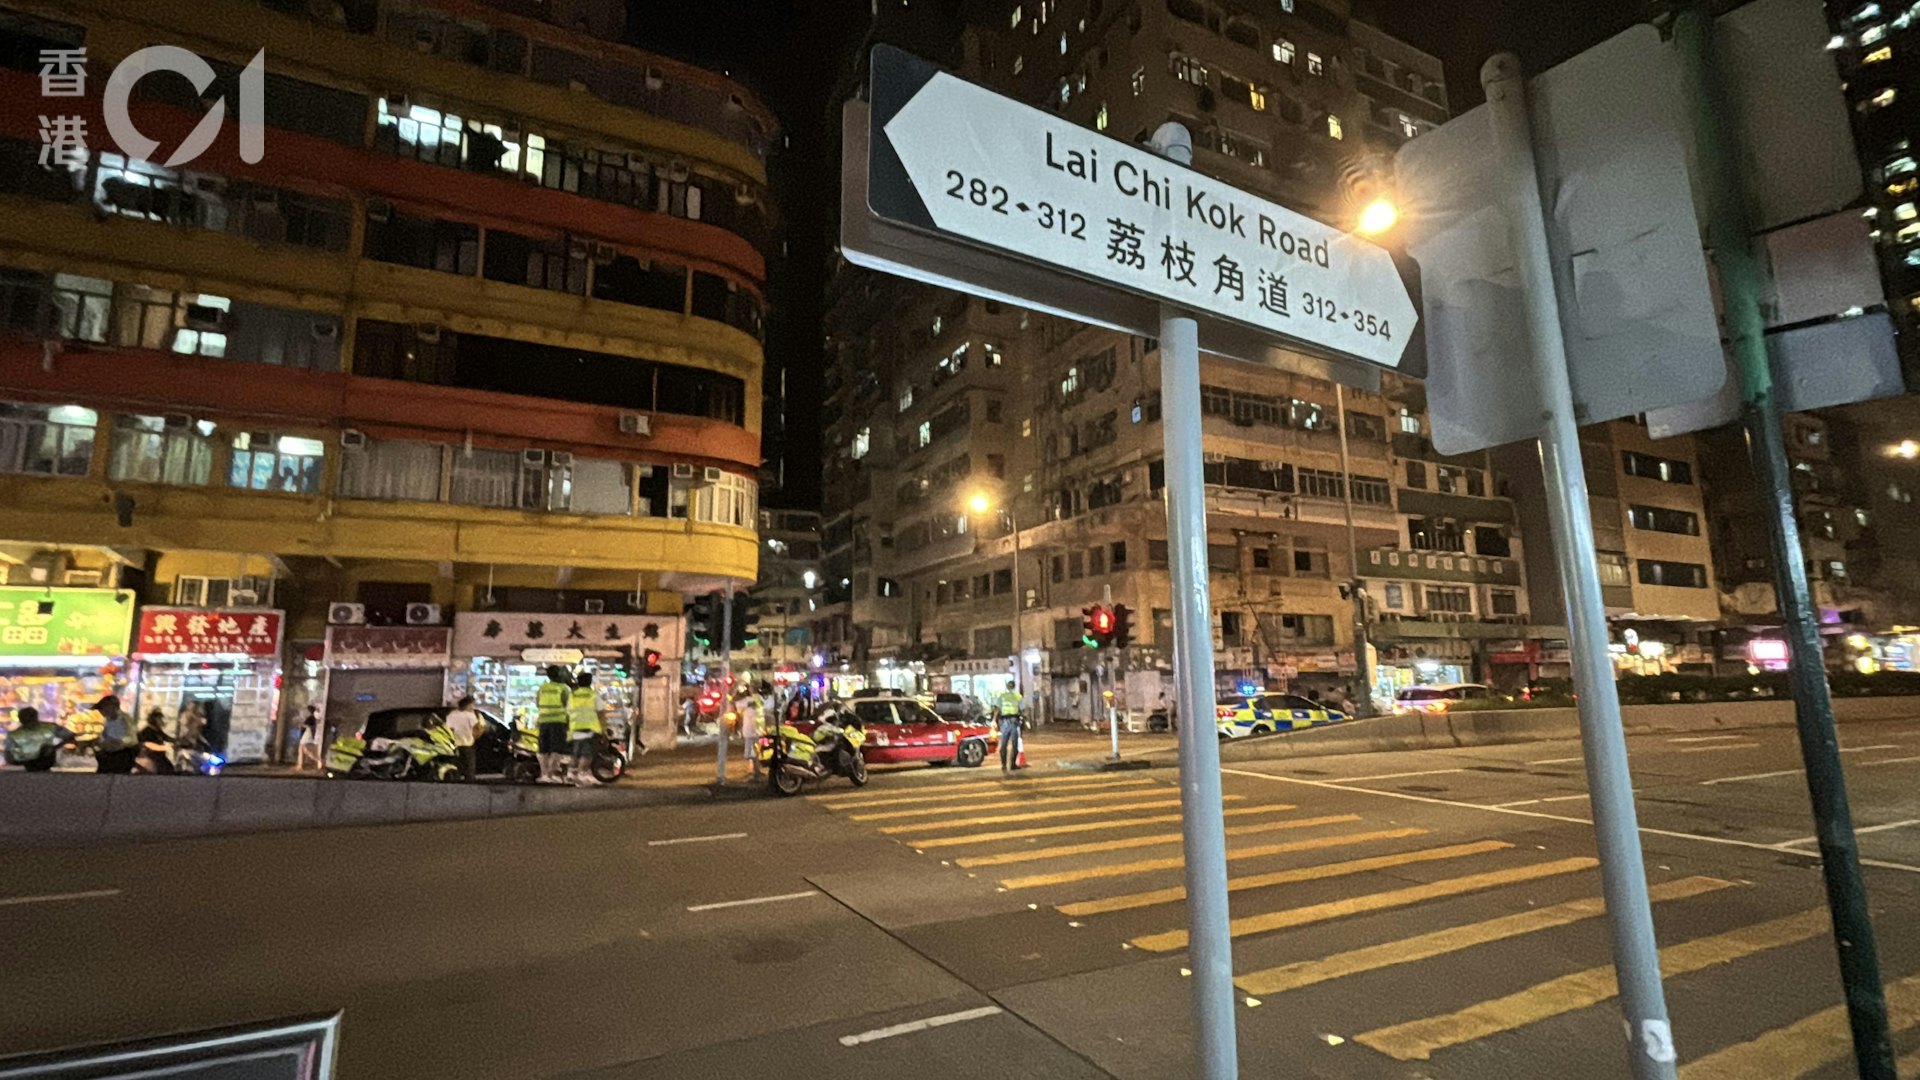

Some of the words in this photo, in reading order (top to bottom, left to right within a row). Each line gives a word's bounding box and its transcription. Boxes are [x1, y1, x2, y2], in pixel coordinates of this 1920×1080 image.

[1046, 131, 1097, 183] Lai
[1114, 160, 1171, 210] Chi
[1187, 186, 1246, 238] Kok
[1259, 213, 1329, 269] Road
[1106, 217, 1290, 318] 荔枝角道
